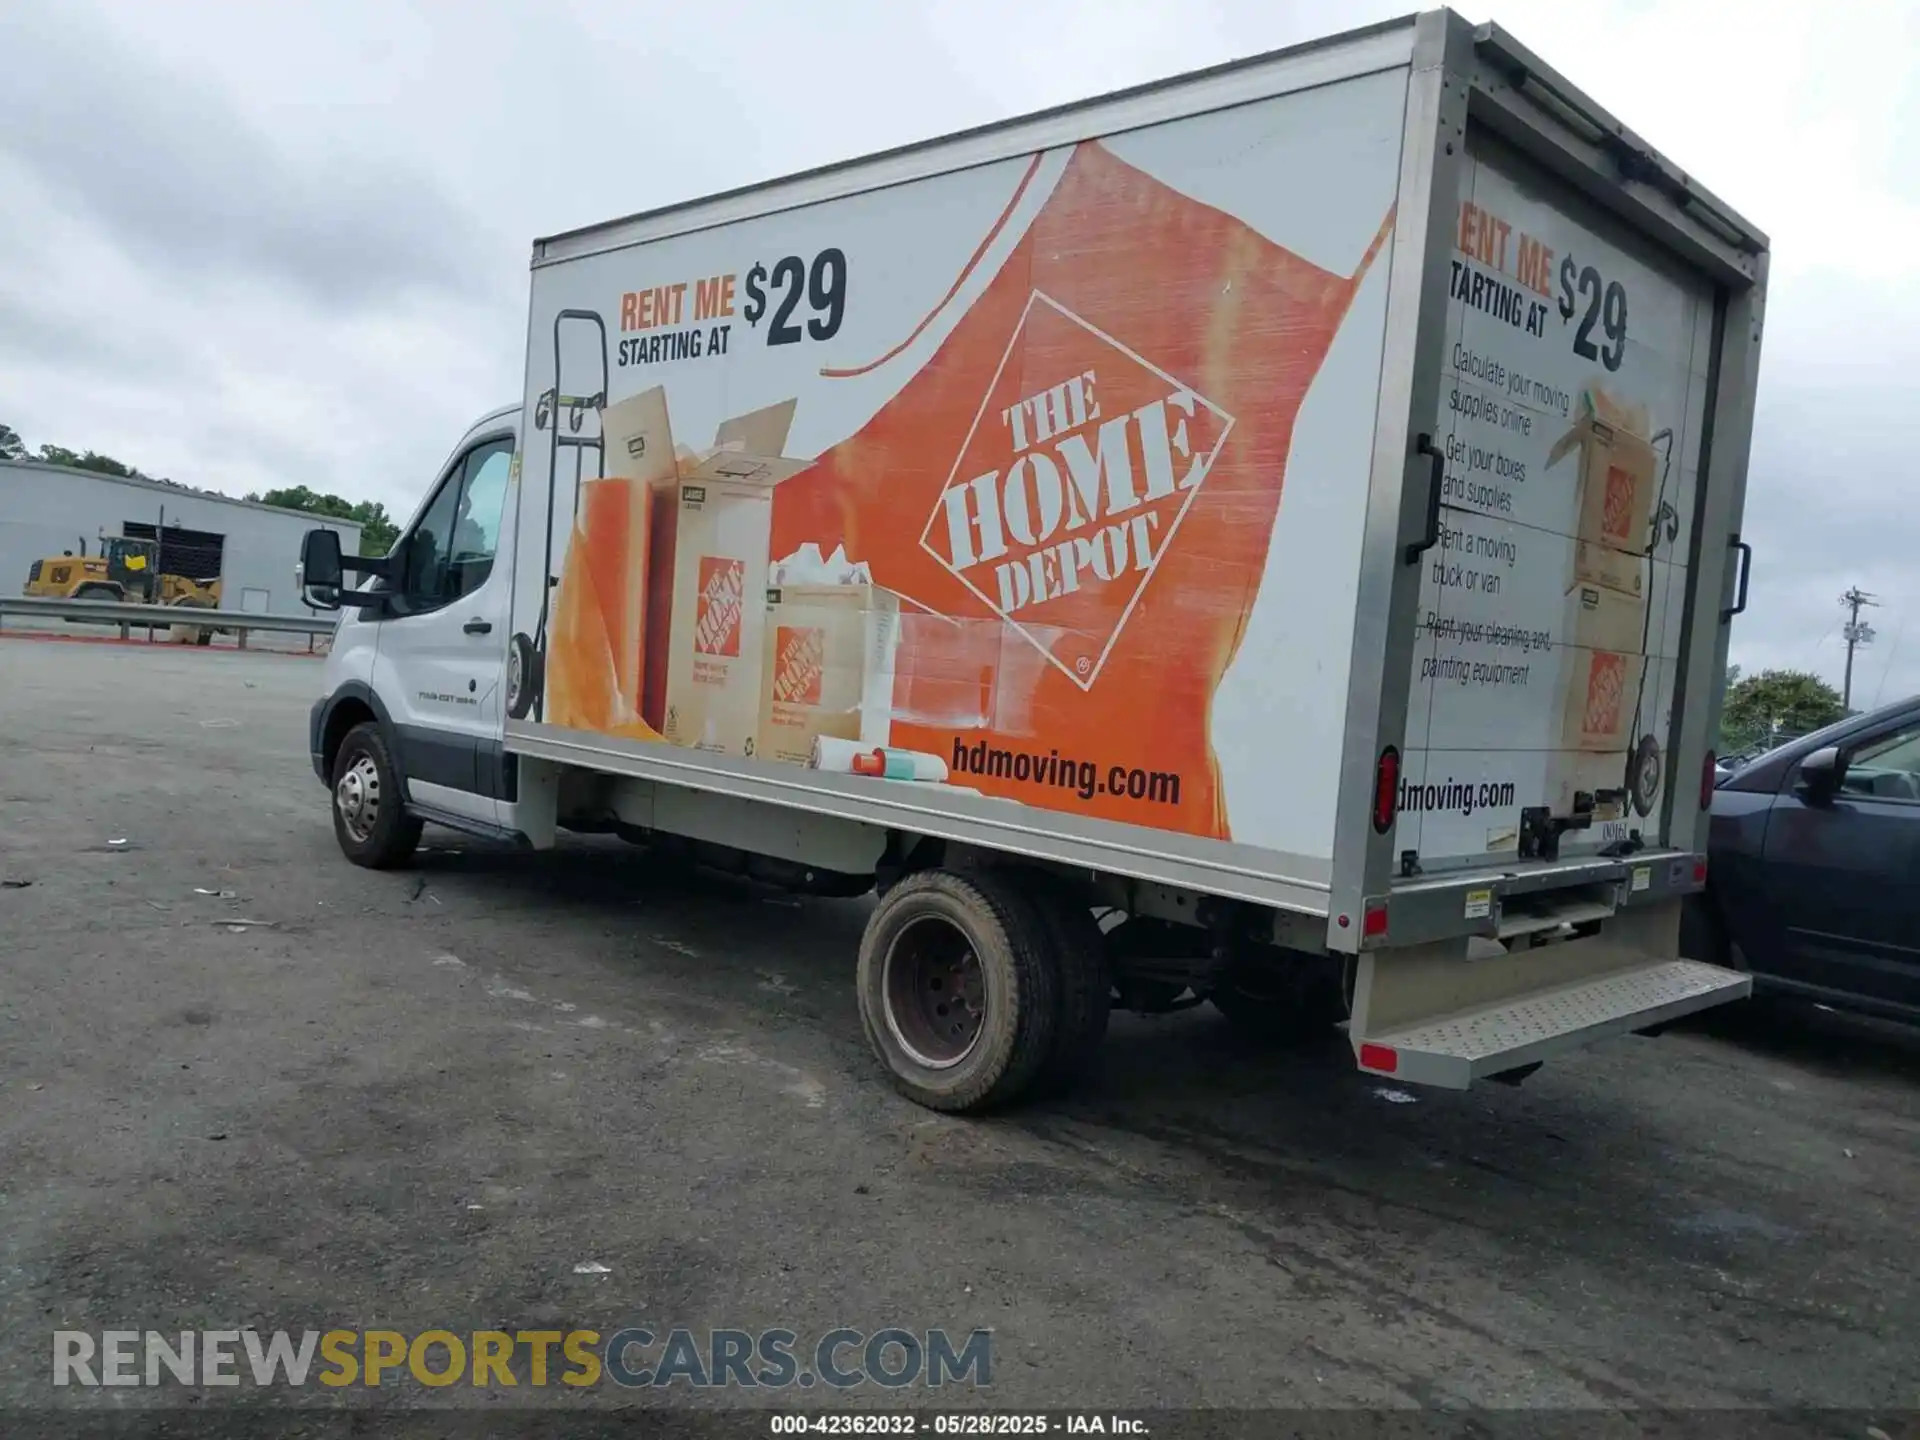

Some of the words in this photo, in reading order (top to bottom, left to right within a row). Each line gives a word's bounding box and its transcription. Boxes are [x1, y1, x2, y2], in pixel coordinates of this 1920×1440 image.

[1459, 200, 1512, 272] ENT
[1517, 232, 1554, 298] ME
[620, 283, 688, 332] RENT
[694, 274, 736, 321] ME
[743, 248, 847, 346] $29
[1450, 260, 1522, 327] TARTING
[1526, 300, 1548, 338] AT
[1558, 251, 1627, 373] $29
[618, 328, 701, 367] STARTING
[707, 325, 731, 356] AT
[1453, 343, 1505, 387] Calculate
[1507, 371, 1531, 396] your
[1534, 381, 1570, 418] moving
[1001, 369, 1100, 453] THE
[1449, 389, 1498, 424] supplies
[1501, 408, 1532, 437] online
[942, 391, 1212, 573] HOME
[1446, 433, 1466, 464] Get
[1467, 445, 1494, 472] your
[1496, 447, 1527, 482] boxes
[1443, 475, 1464, 499] and
[1467, 482, 1512, 512] supplies
[995, 510, 1158, 614] DEPOT
[1437, 521, 1463, 551] Rent
[1466, 534, 1473, 553] a
[1477, 535, 1516, 568] moving
[1432, 558, 1464, 587] truck
[1466, 570, 1479, 591] or
[1481, 573, 1501, 595] van
[1426, 611, 1456, 640] Rent
[1458, 621, 1483, 646] your
[1486, 620, 1529, 653] cleaning
[1533, 629, 1551, 651] and
[1421, 655, 1471, 686] painting
[1473, 658, 1530, 687] equipment
[952, 737, 1180, 804] hdmoving.com
[1397, 777, 1515, 816] dmoving.com
